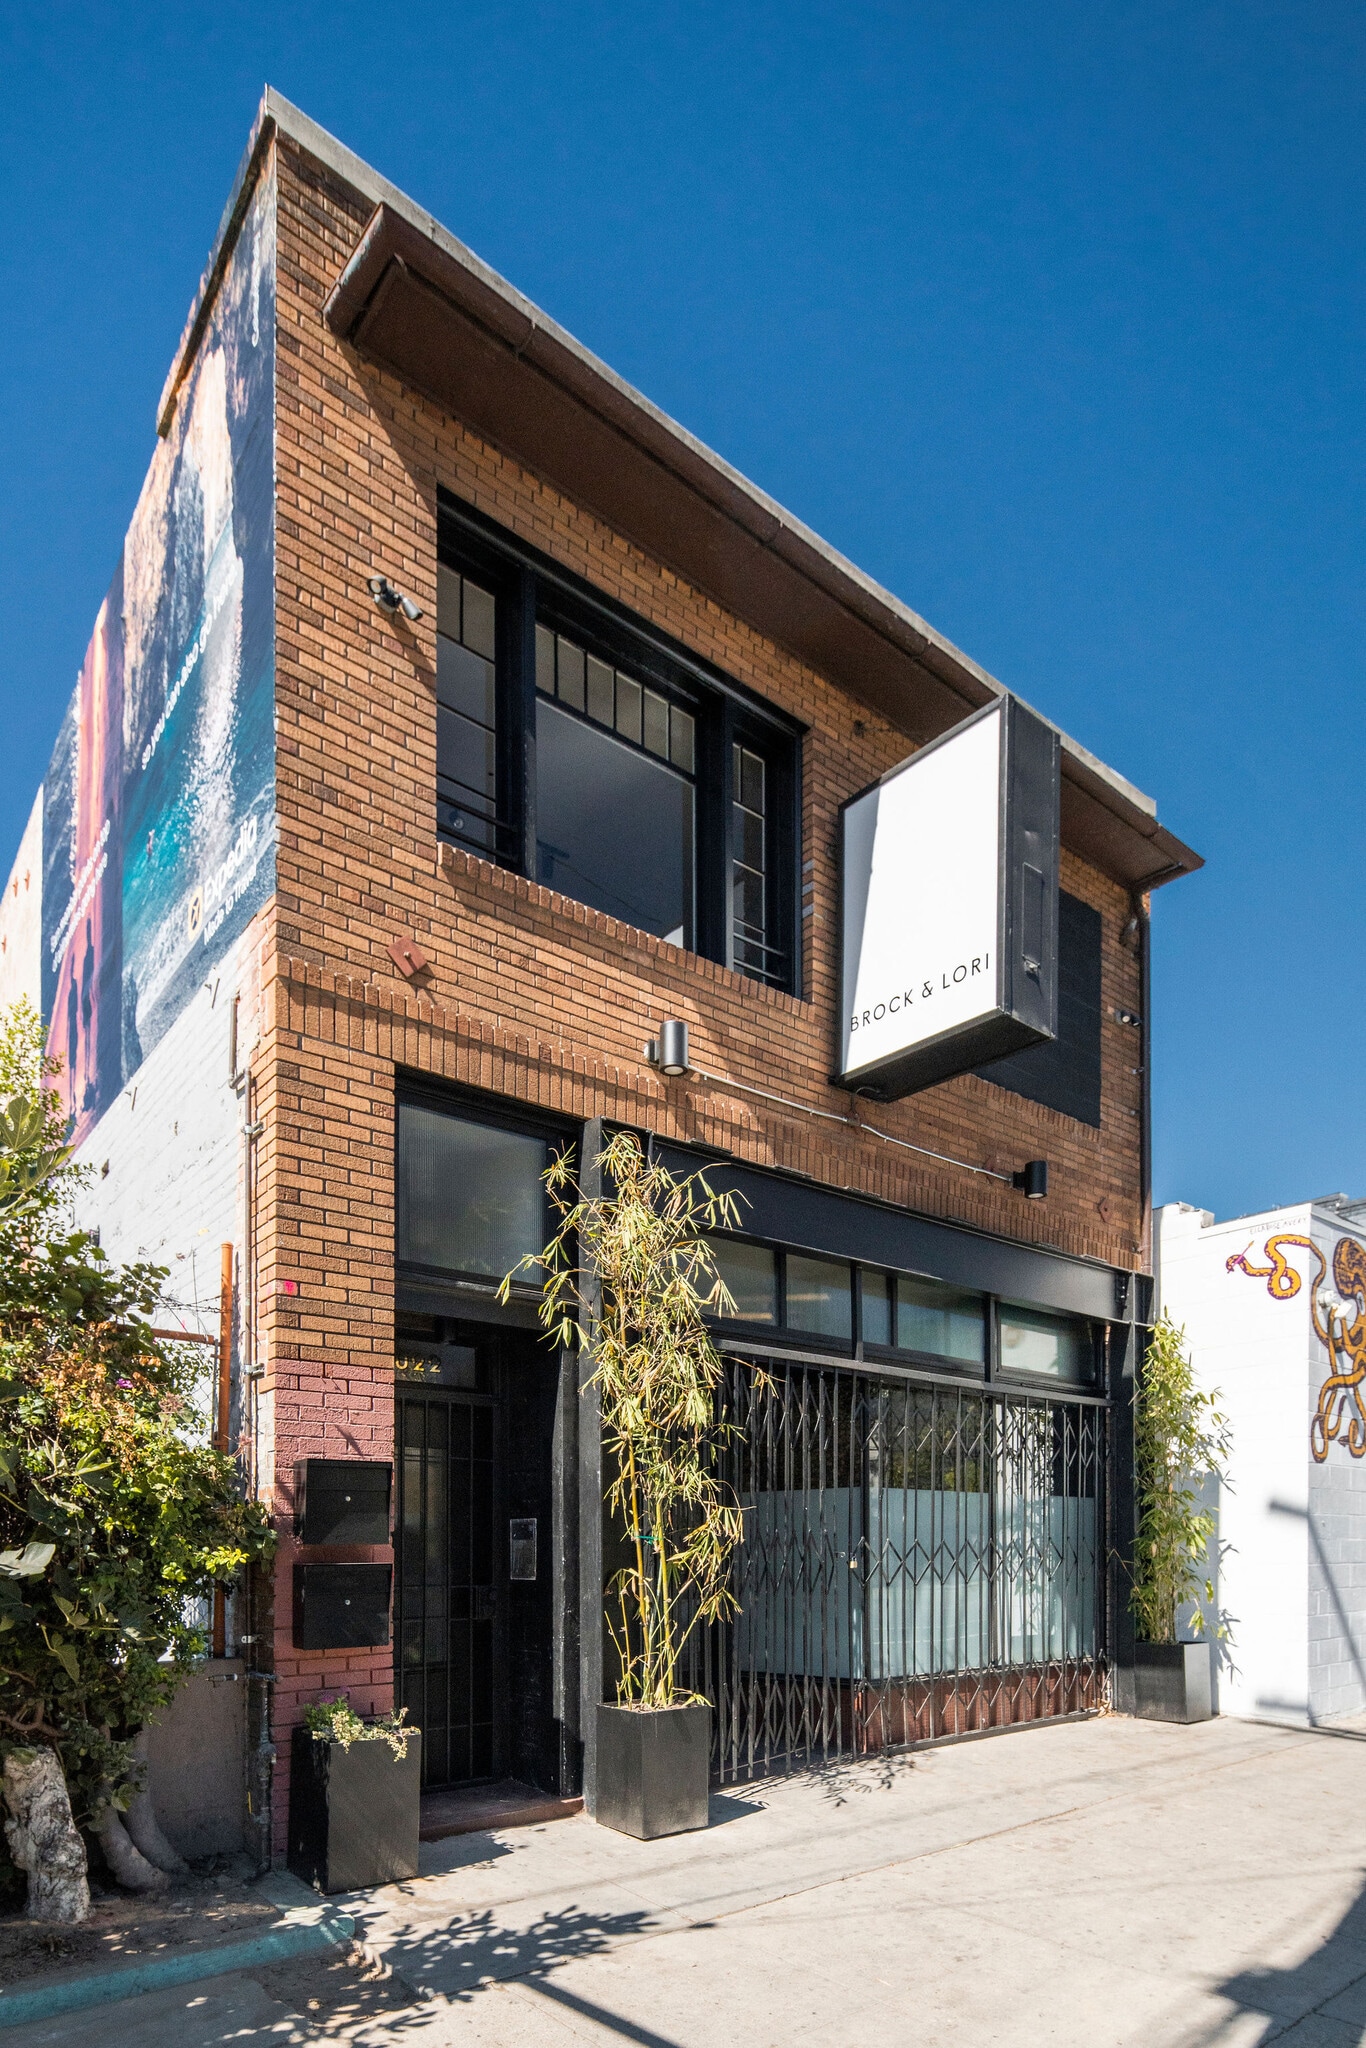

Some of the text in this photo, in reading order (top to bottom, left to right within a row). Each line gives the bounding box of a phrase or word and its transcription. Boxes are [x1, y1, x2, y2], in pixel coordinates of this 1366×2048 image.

[204, 815, 257, 913] Expedia
[850, 953, 989, 1032] BROCK & LORI
